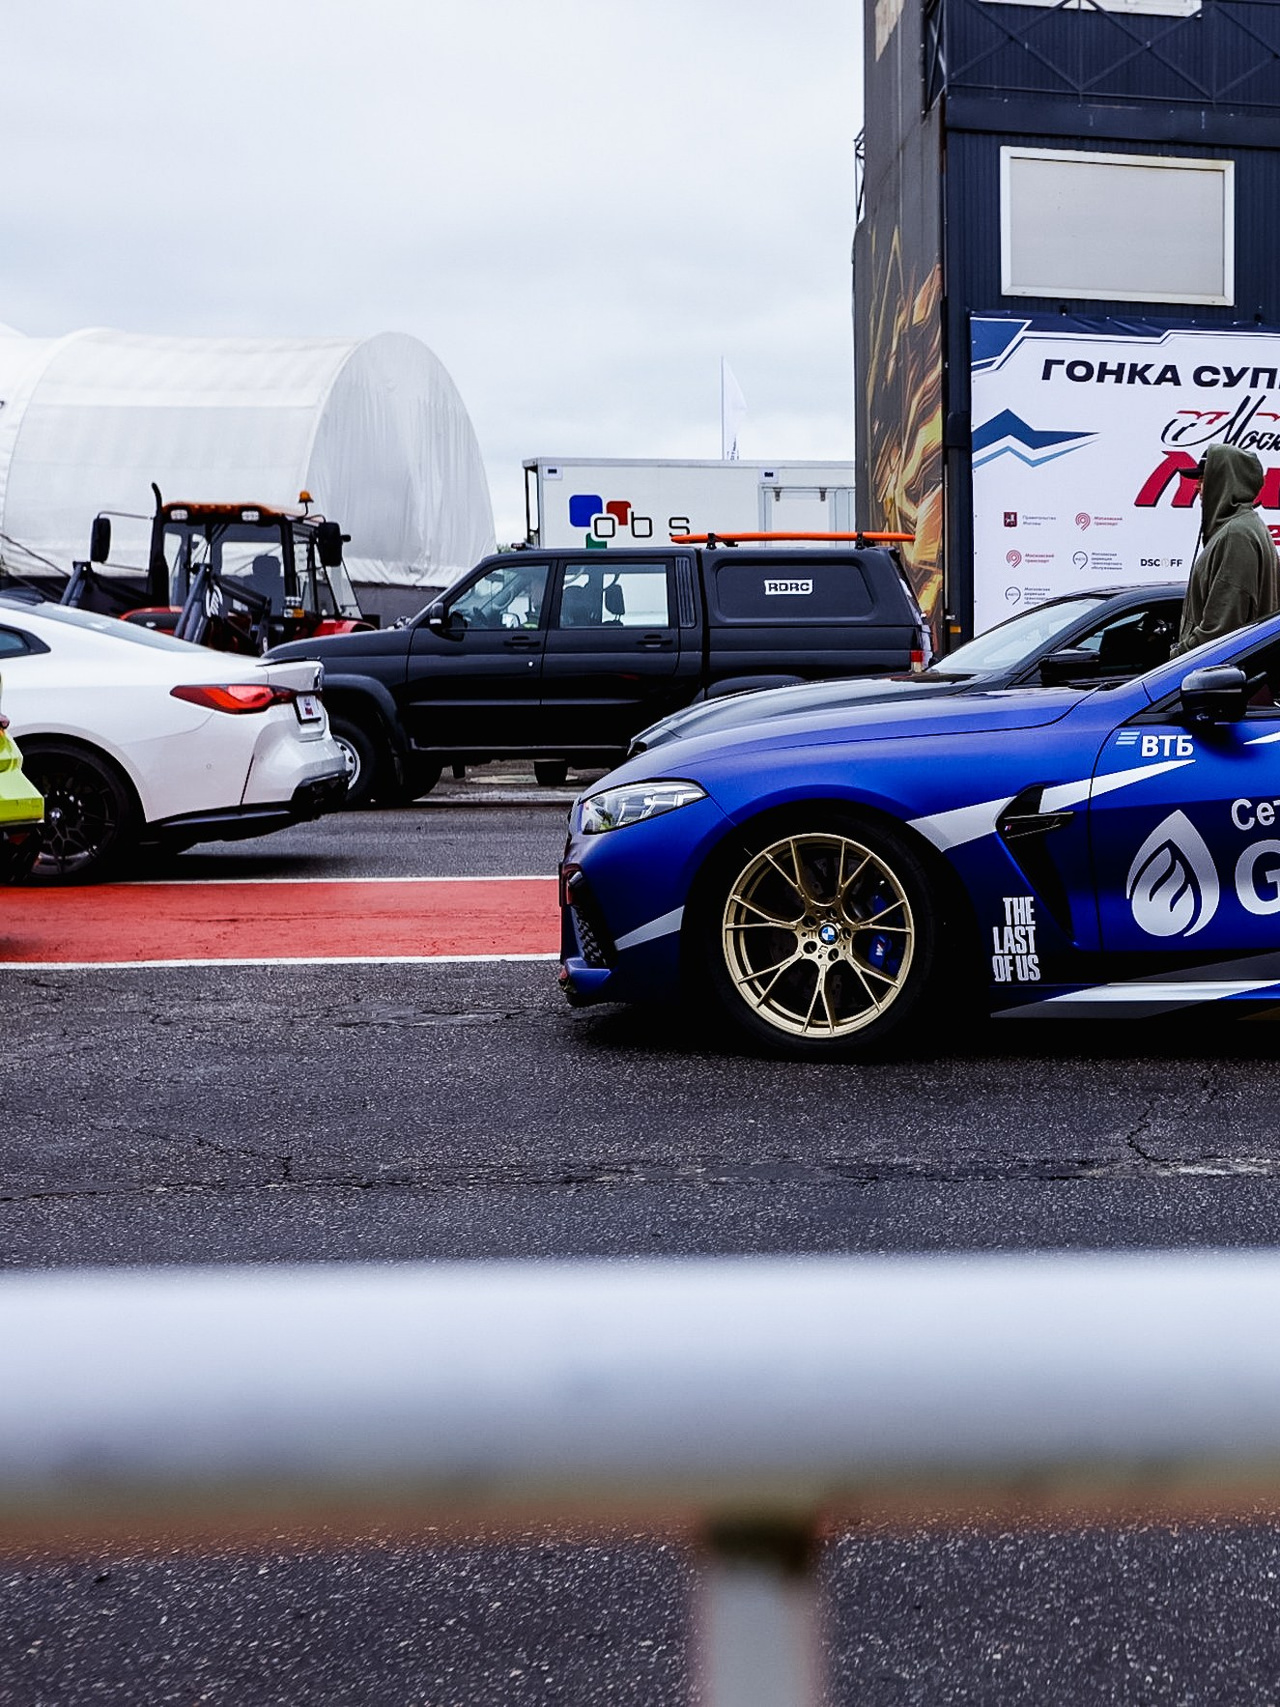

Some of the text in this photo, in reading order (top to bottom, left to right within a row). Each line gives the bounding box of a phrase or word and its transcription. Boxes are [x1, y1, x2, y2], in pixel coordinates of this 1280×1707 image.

[1041, 358, 1182, 386] ГОНКА
[1141, 734, 1194, 757] ВТБ
[1003, 896, 1036, 925] THE
[992, 926, 1036, 954] LAST
[992, 954, 1041, 982] OF US
